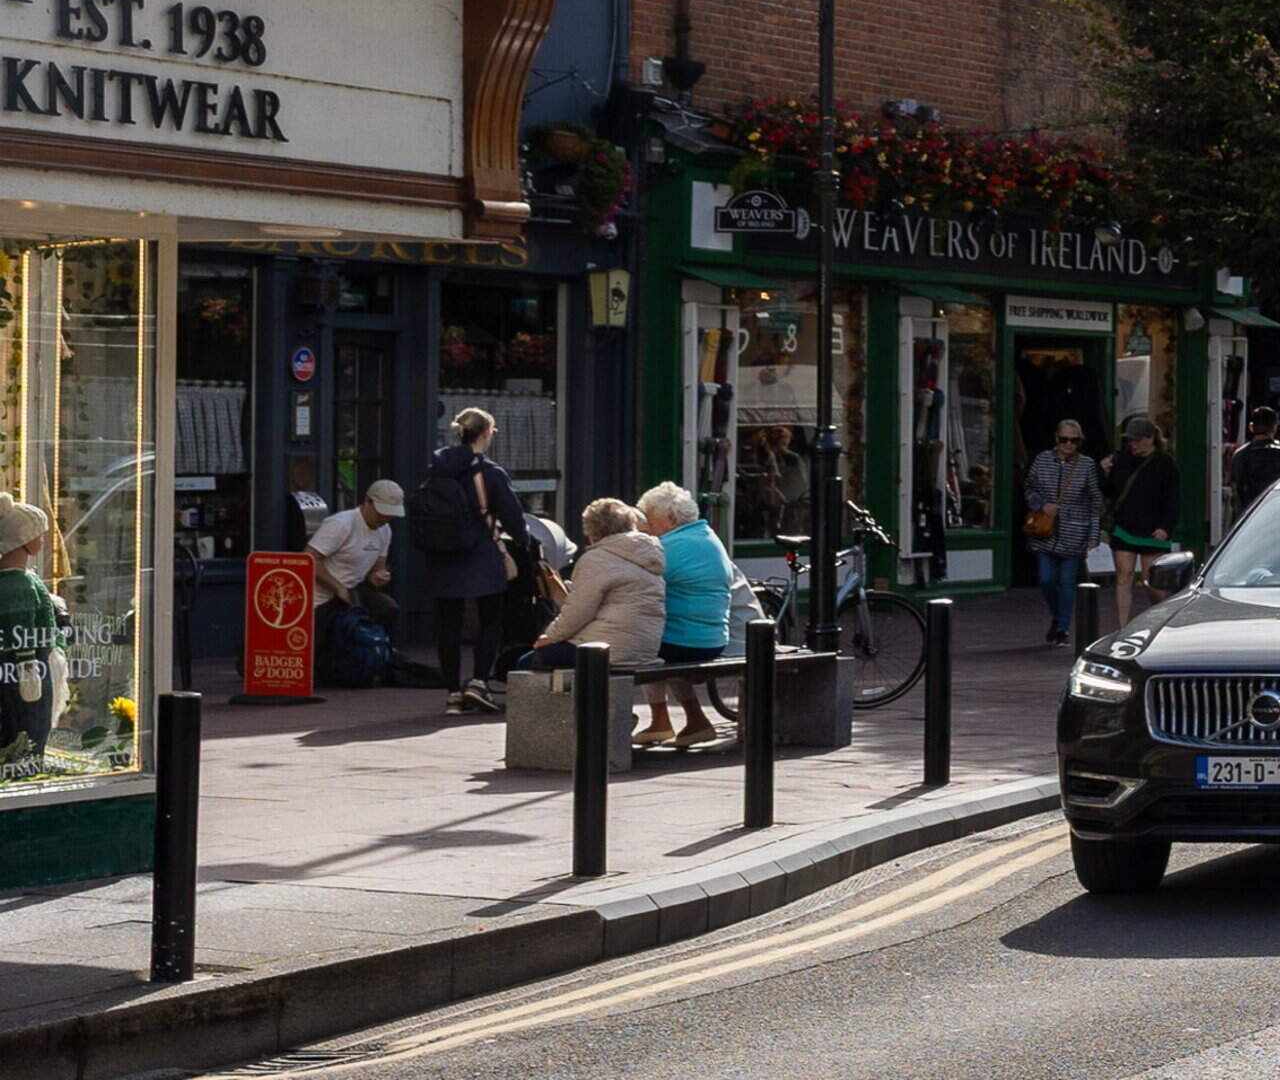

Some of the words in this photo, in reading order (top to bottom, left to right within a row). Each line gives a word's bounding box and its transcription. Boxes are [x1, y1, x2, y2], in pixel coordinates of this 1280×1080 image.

[168, 2, 266, 67] 1938
[2, 56, 290, 143] KNITWEAR
[728, 209, 784, 220] WEAVERS
[831, 208, 981, 261] WEAVERS
[989, 232, 1018, 259] OF
[1029, 229, 1147, 275] IRELAND
[253, 667, 265, 679] &
[266, 668, 304, 680] DODO
[255, 655, 304, 668] BADGER
